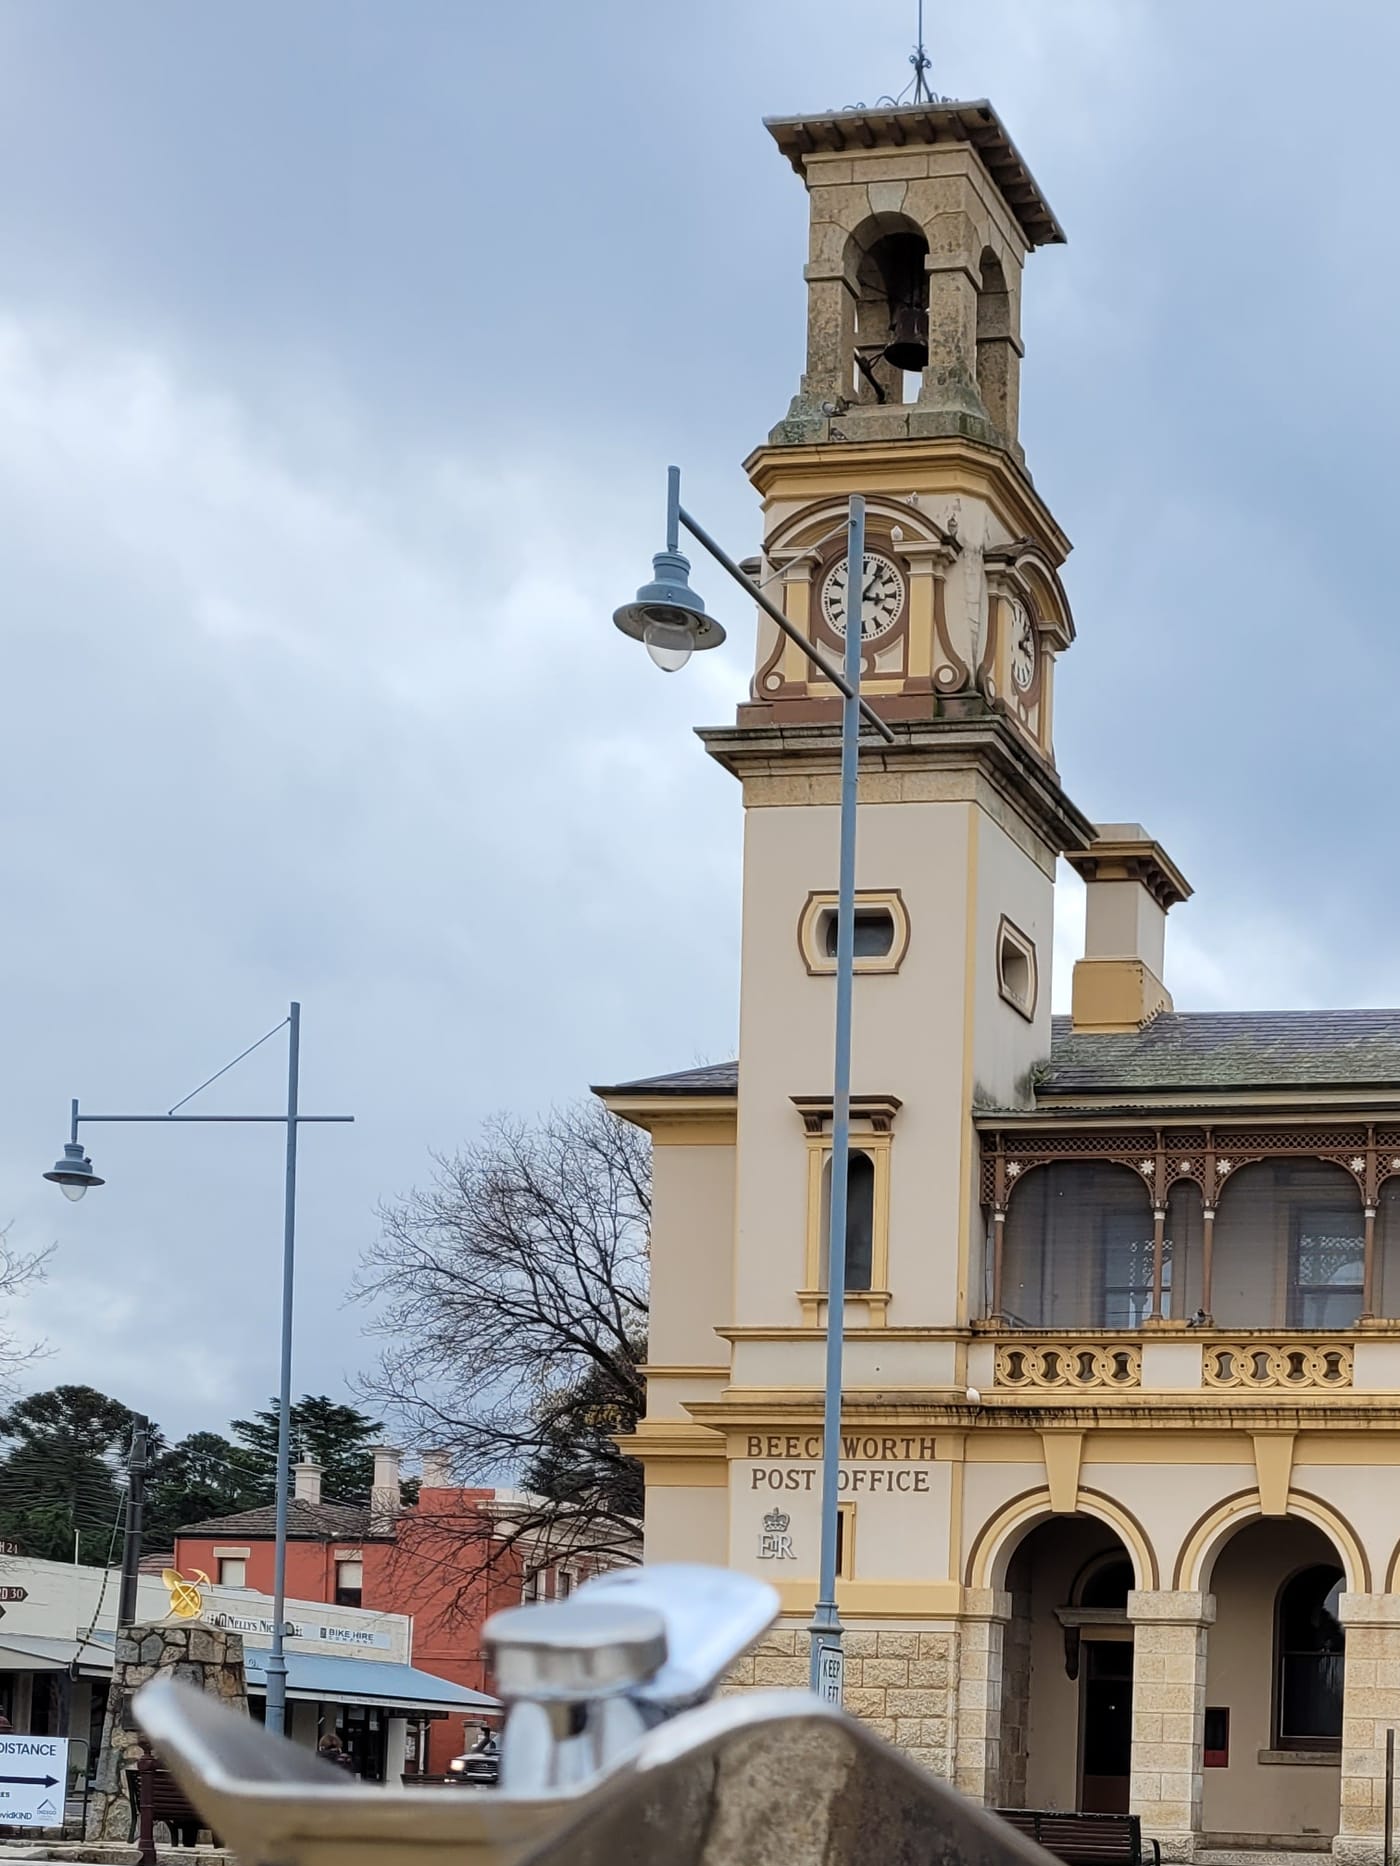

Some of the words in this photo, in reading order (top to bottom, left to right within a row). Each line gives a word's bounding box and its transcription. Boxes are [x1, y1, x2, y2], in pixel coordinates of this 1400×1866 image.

[747, 1436, 936, 1460] BEECWORTH
[751, 1468, 816, 1490] POST
[837, 1469, 930, 1492] OFFICE
[10, 1588, 24, 1599] 30
[329, 1628, 351, 1639] BIKE
[353, 1631, 375, 1641] HIRE
[823, 1658, 841, 1679] KEEP
